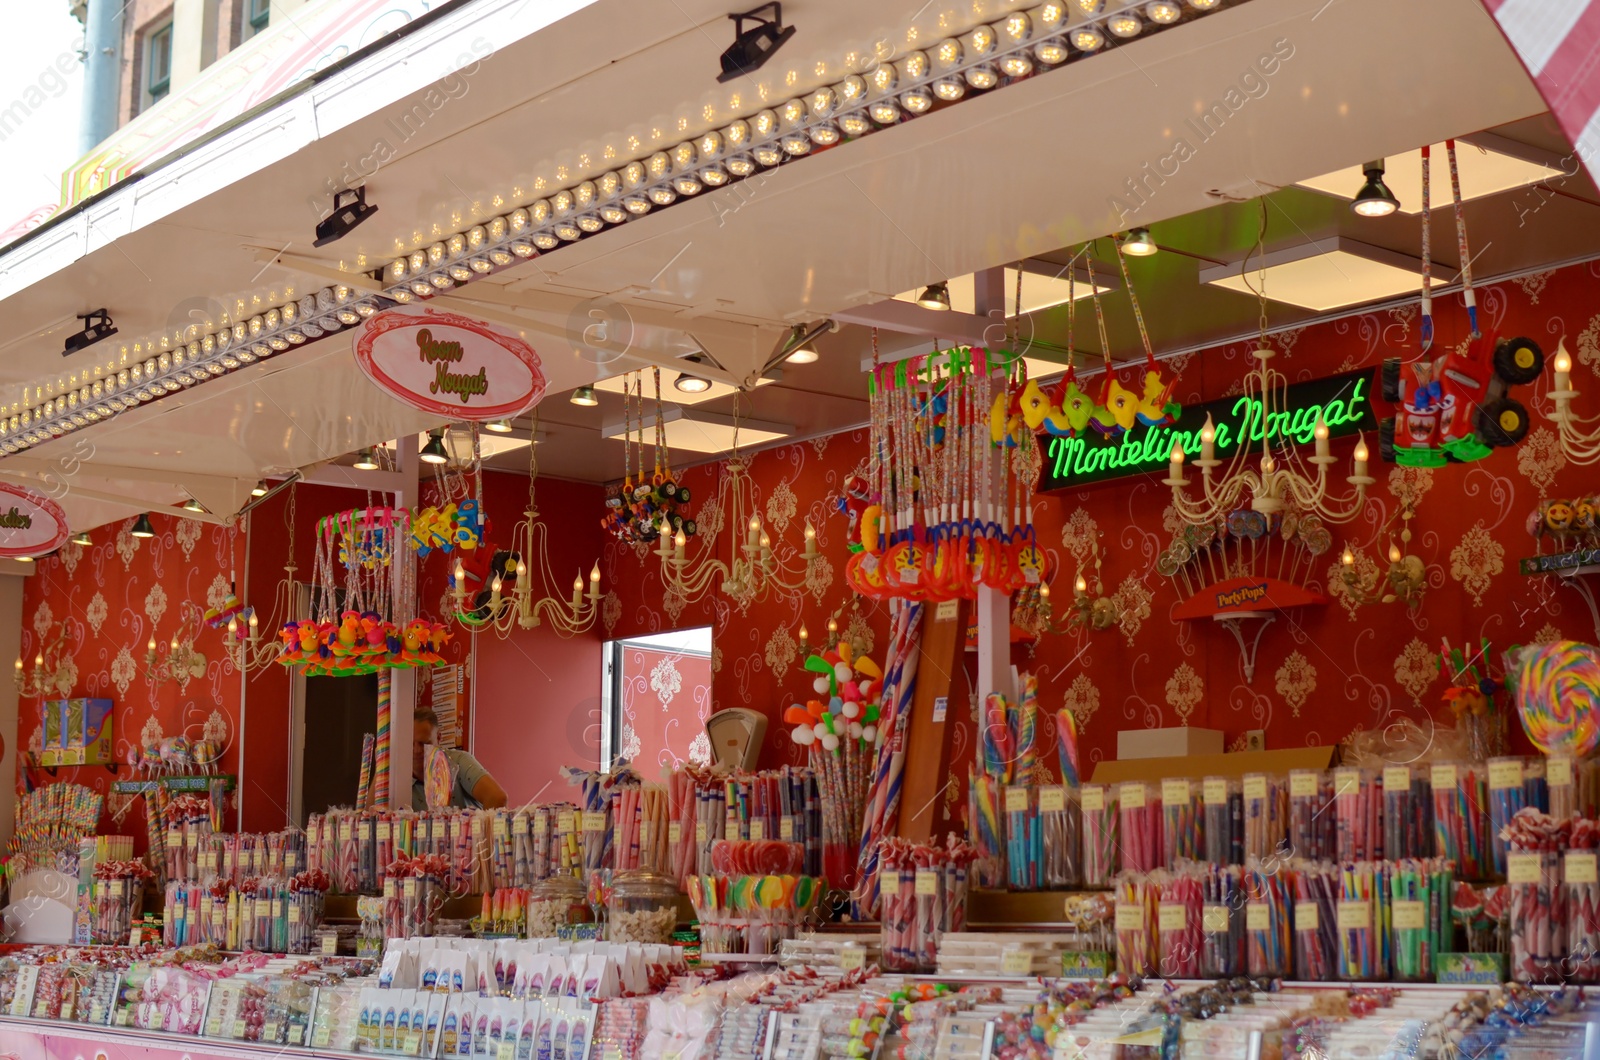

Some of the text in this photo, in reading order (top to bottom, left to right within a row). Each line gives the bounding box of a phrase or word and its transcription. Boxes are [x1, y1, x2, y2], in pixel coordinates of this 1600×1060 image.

[416, 328, 464, 364] Room
[429, 362, 488, 403] Nougat
[1231, 377, 1366, 444] Nougat
[120, 782, 140, 792] PLUSH
[169, 778, 206, 789] PLUSH POPS
[557, 928, 596, 940] TOY POPS
